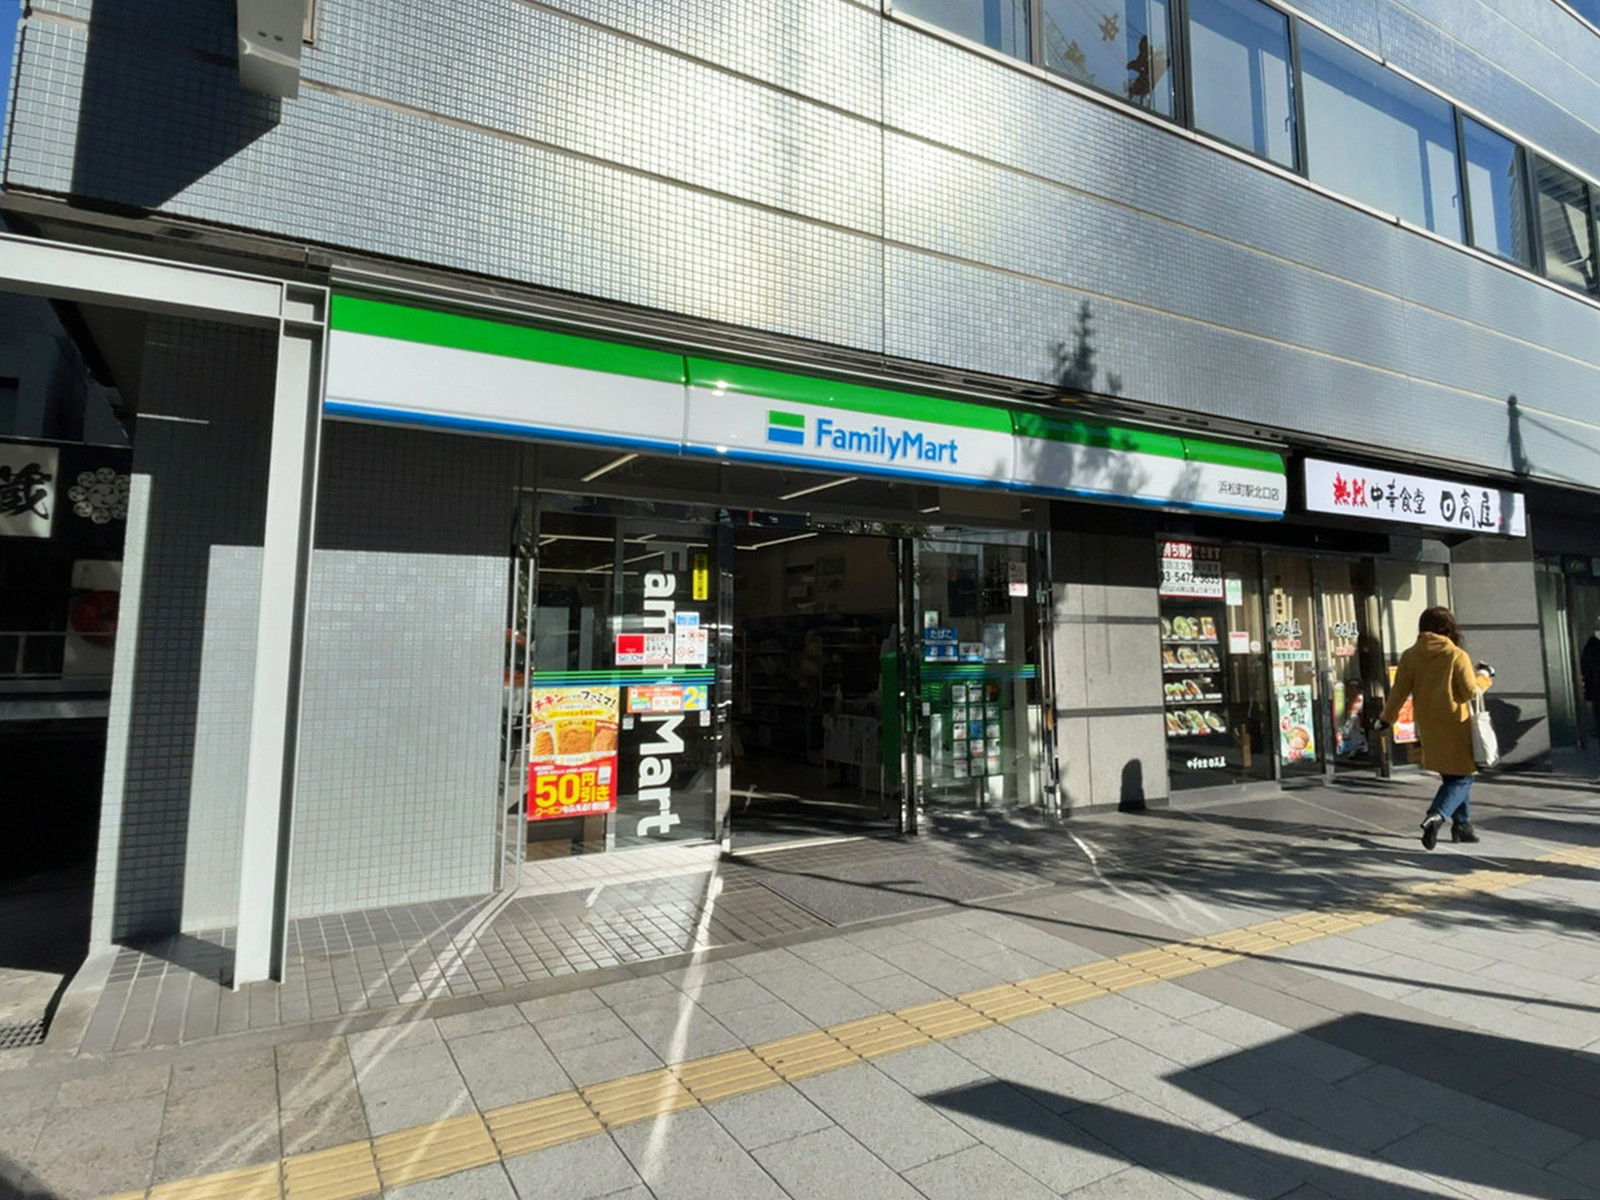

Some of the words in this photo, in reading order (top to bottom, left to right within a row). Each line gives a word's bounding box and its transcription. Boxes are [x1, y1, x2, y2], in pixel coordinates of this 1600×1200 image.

[816, 418, 959, 464] FamilyMart
[1218, 480, 1280, 502] 浜松町駅北口店
[1332, 471, 1368, 507] 熱烈
[1370, 480, 1427, 515] 中華食堂
[1440, 488, 1496, 528] 日高屋
